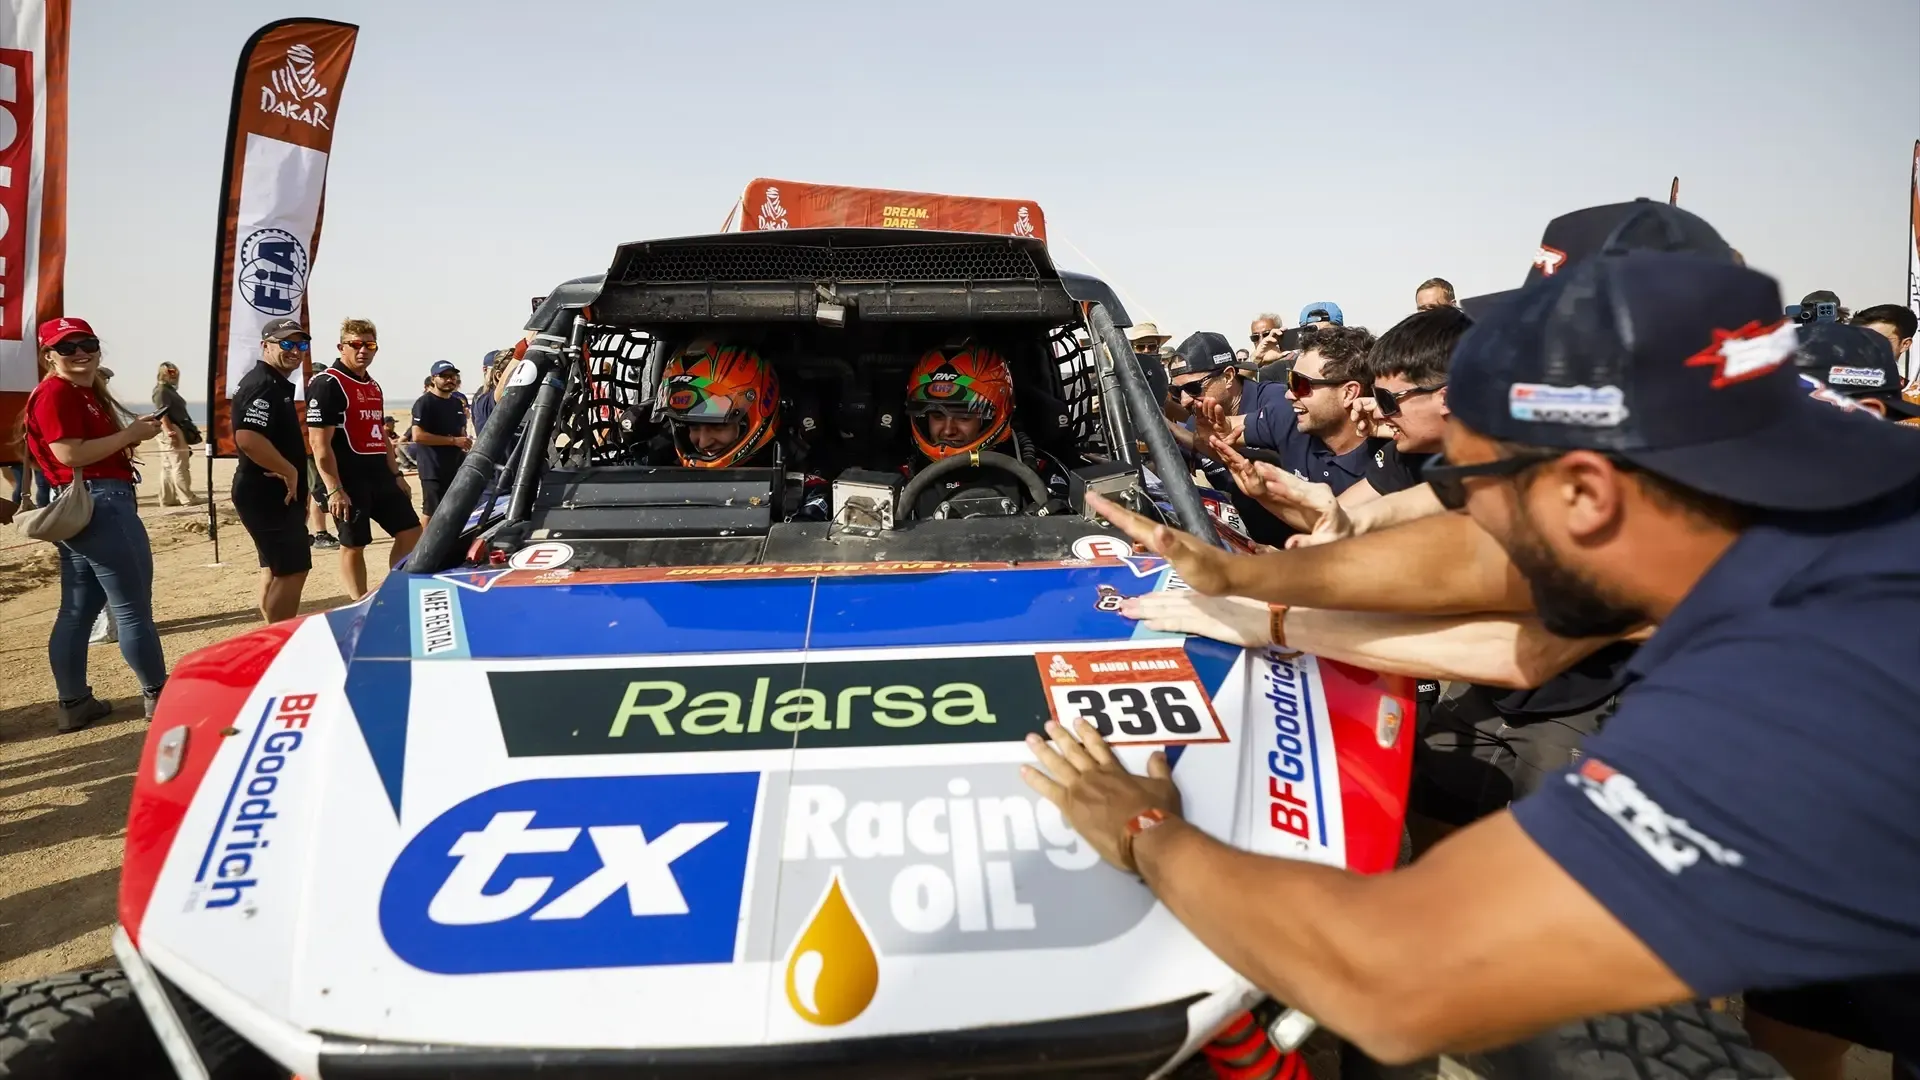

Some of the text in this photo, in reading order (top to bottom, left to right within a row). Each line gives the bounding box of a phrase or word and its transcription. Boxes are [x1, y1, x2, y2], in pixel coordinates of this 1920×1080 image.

[260, 86, 330, 130] DAKAR
[883, 206, 929, 219] DREAM.
[883, 217, 919, 229] DARE.
[243, 416, 267, 427] IVECO
[371, 424, 382, 441] 4
[525, 549, 558, 564] E
[1088, 541, 1118, 559] E
[665, 566, 776, 576] DREAM.
[784, 563, 868, 572] DARE.
[875, 562, 937, 570] LIVE
[425, 613, 453, 653] RENTAL
[1089, 659, 1180, 673] SAUDI ARABIA
[608, 677, 997, 738] Ralarsa
[1067, 686, 1202, 737] 336
[205, 693, 318, 910] BFGoodrich
[783, 778, 1101, 871] Racing
[427, 809, 730, 927] tx
